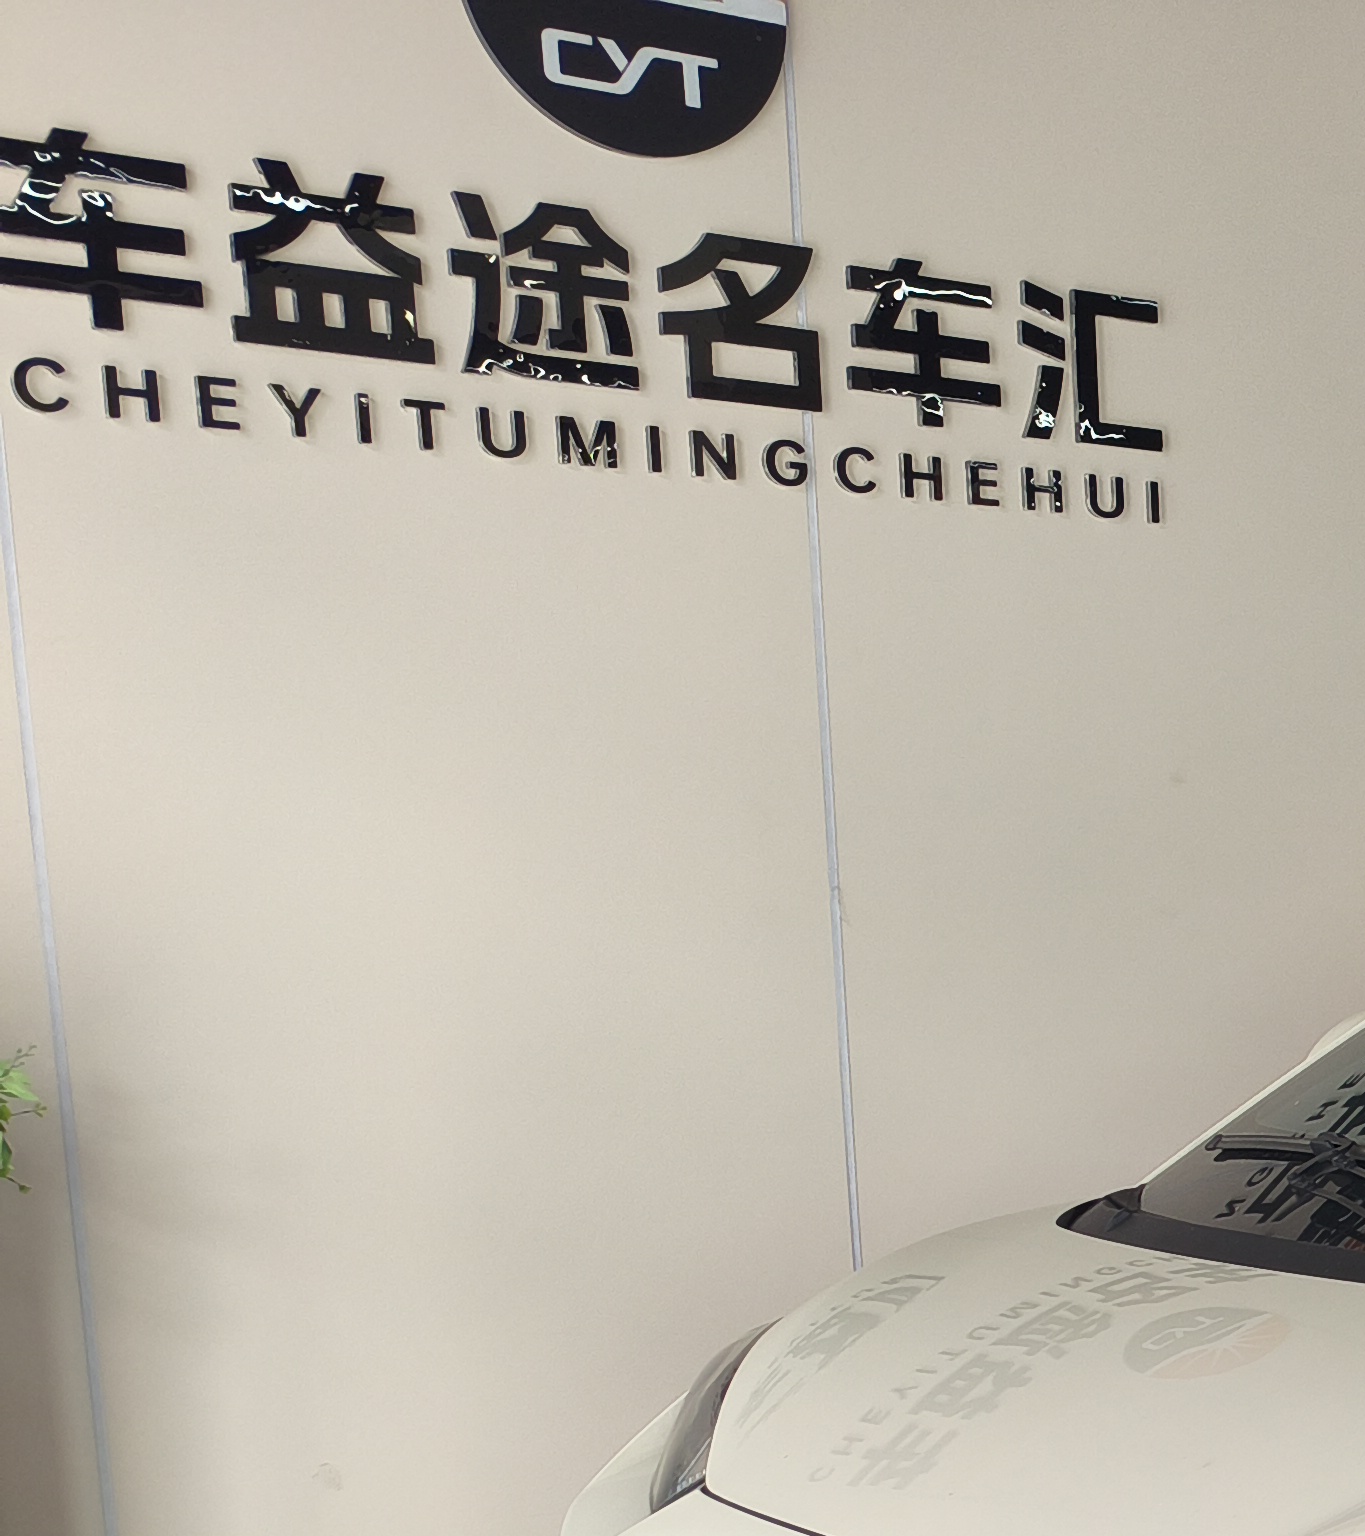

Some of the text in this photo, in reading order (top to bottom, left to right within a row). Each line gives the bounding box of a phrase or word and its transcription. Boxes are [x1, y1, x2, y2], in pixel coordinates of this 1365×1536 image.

[541, 27, 719, 109] CYT
[0, 127, 1164, 452] 车益途名车汇
[10, 355, 1163, 525] CHEYITUMINGCHEHUI
